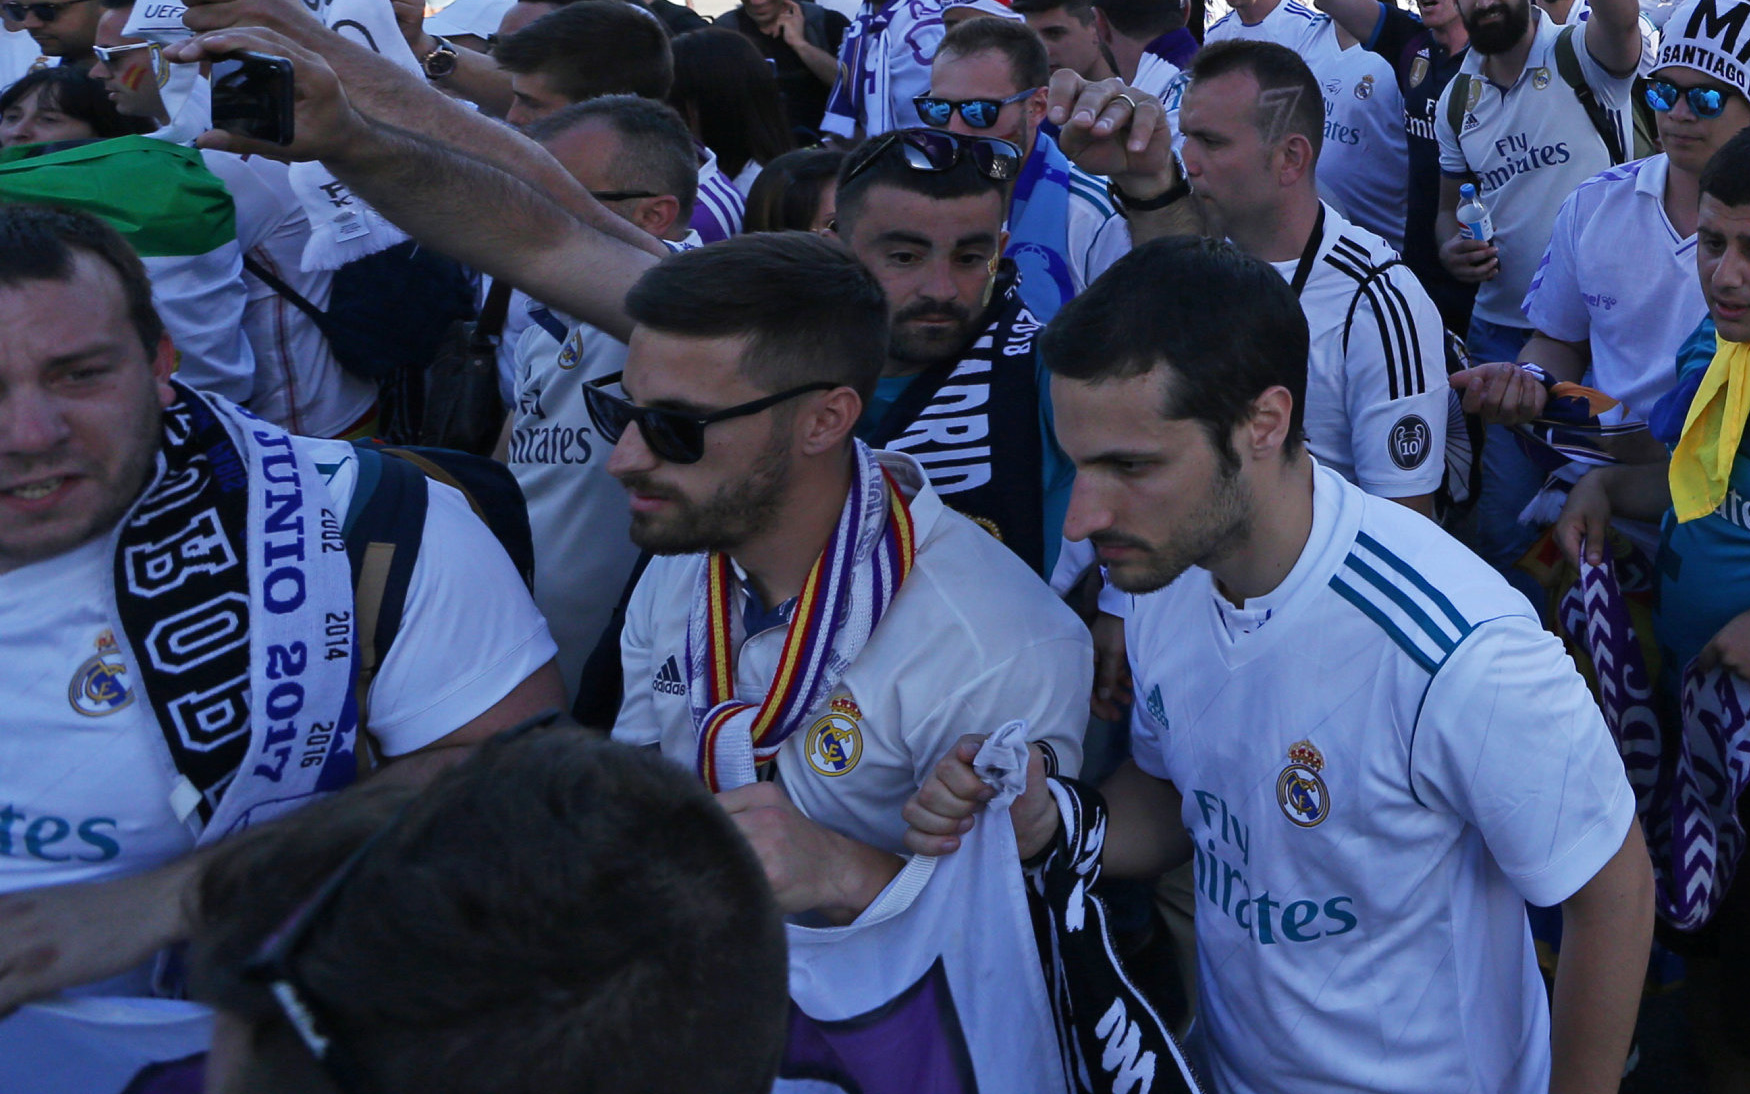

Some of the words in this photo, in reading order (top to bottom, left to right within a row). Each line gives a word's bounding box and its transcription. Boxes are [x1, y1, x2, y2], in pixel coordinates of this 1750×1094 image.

[1662, 45, 1745, 88] SANTIAGO
[1495, 132, 1528, 157] Fly
[1402, 441, 1419, 455] 10
[254, 430, 307, 615] JUNIO
[320, 508, 346, 554] 2002
[324, 611, 350, 661] 2014
[652, 679, 686, 696] adidas
[254, 640, 308, 784] 2017
[299, 721, 335, 769] 2016
[1192, 789, 1249, 867] Fly
[1186, 827, 1358, 945] irates
